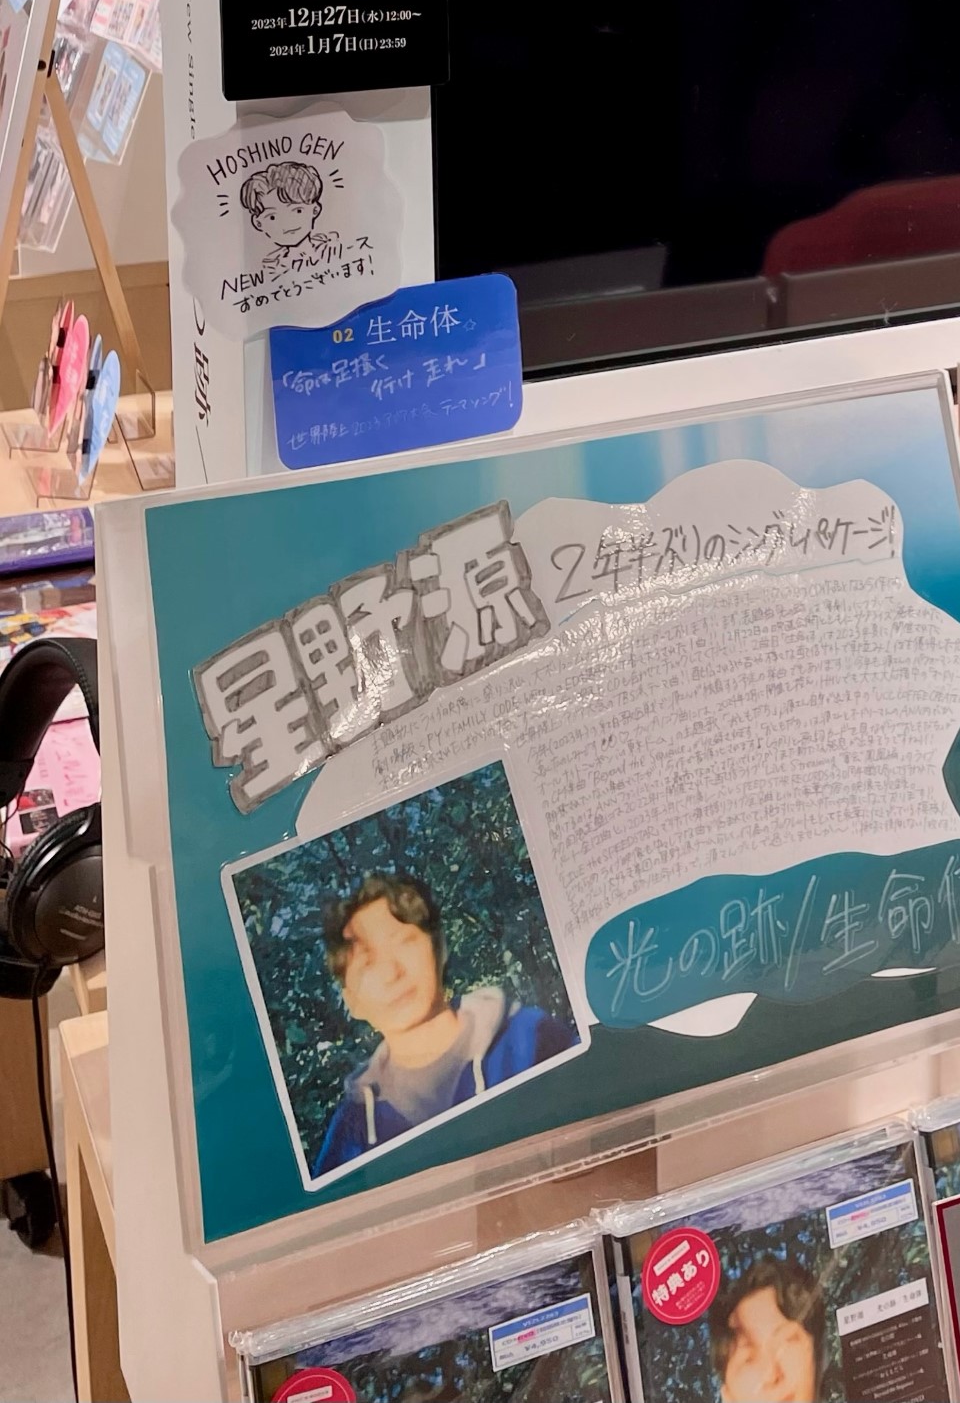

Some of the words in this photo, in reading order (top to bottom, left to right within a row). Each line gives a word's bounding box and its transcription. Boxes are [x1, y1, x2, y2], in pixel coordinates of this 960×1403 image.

[188, 53, 196, 140] Single
[206, 136, 292, 186] HOSHINO
[299, 133, 345, 162] GEN
[332, 328, 355, 345] 02
[366, 304, 461, 346] 生命体
[194, 499, 551, 815] 星野源
[651, 1248, 711, 1307] 特典あり
